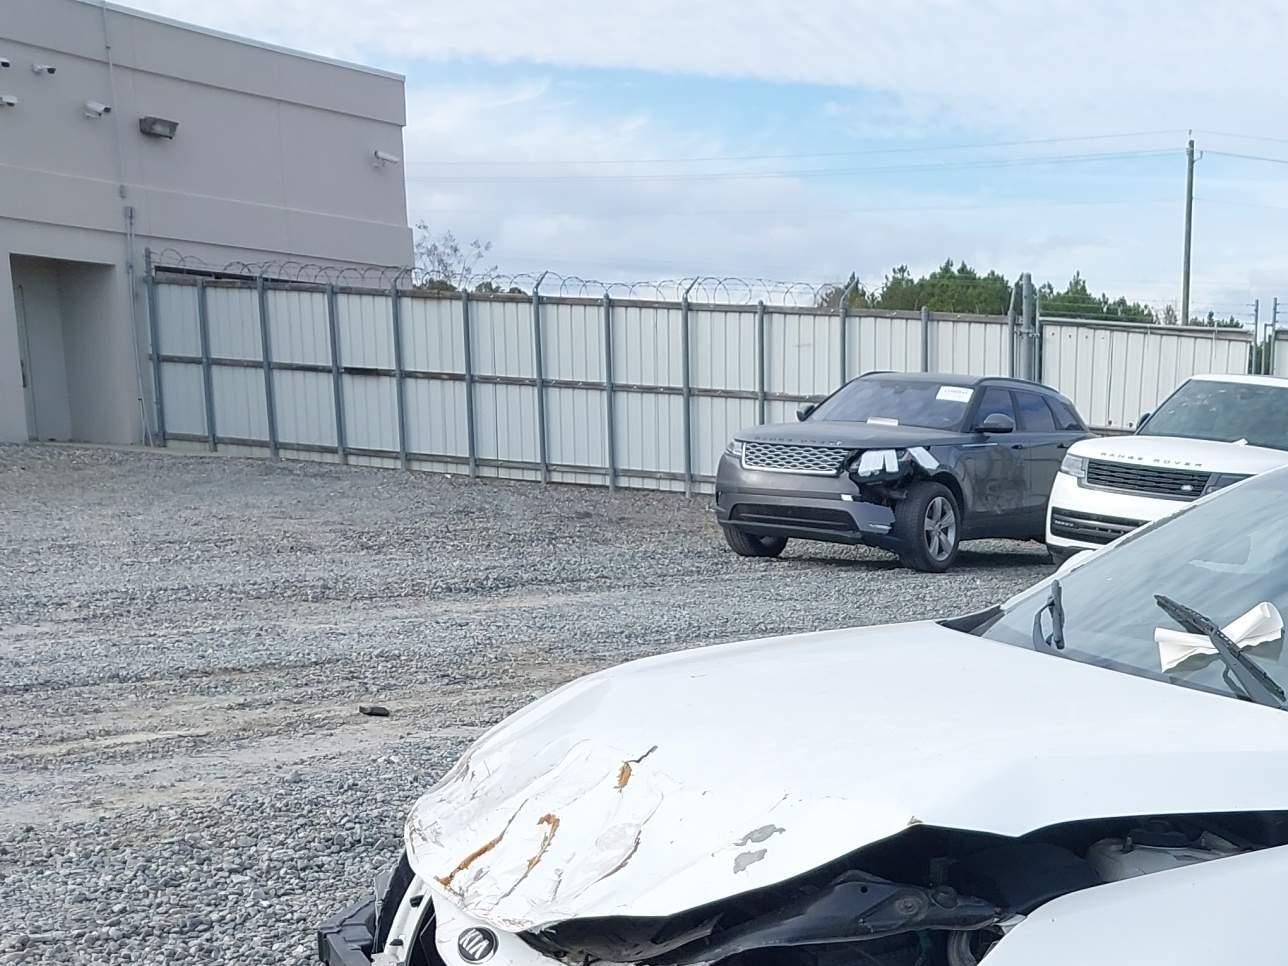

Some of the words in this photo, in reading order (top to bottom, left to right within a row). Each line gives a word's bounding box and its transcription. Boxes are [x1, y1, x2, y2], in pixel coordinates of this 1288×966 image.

[1100, 452, 1144, 461] RANGE
[1153, 458, 1203, 467] ROVER
[459, 928, 490, 960] KIA
